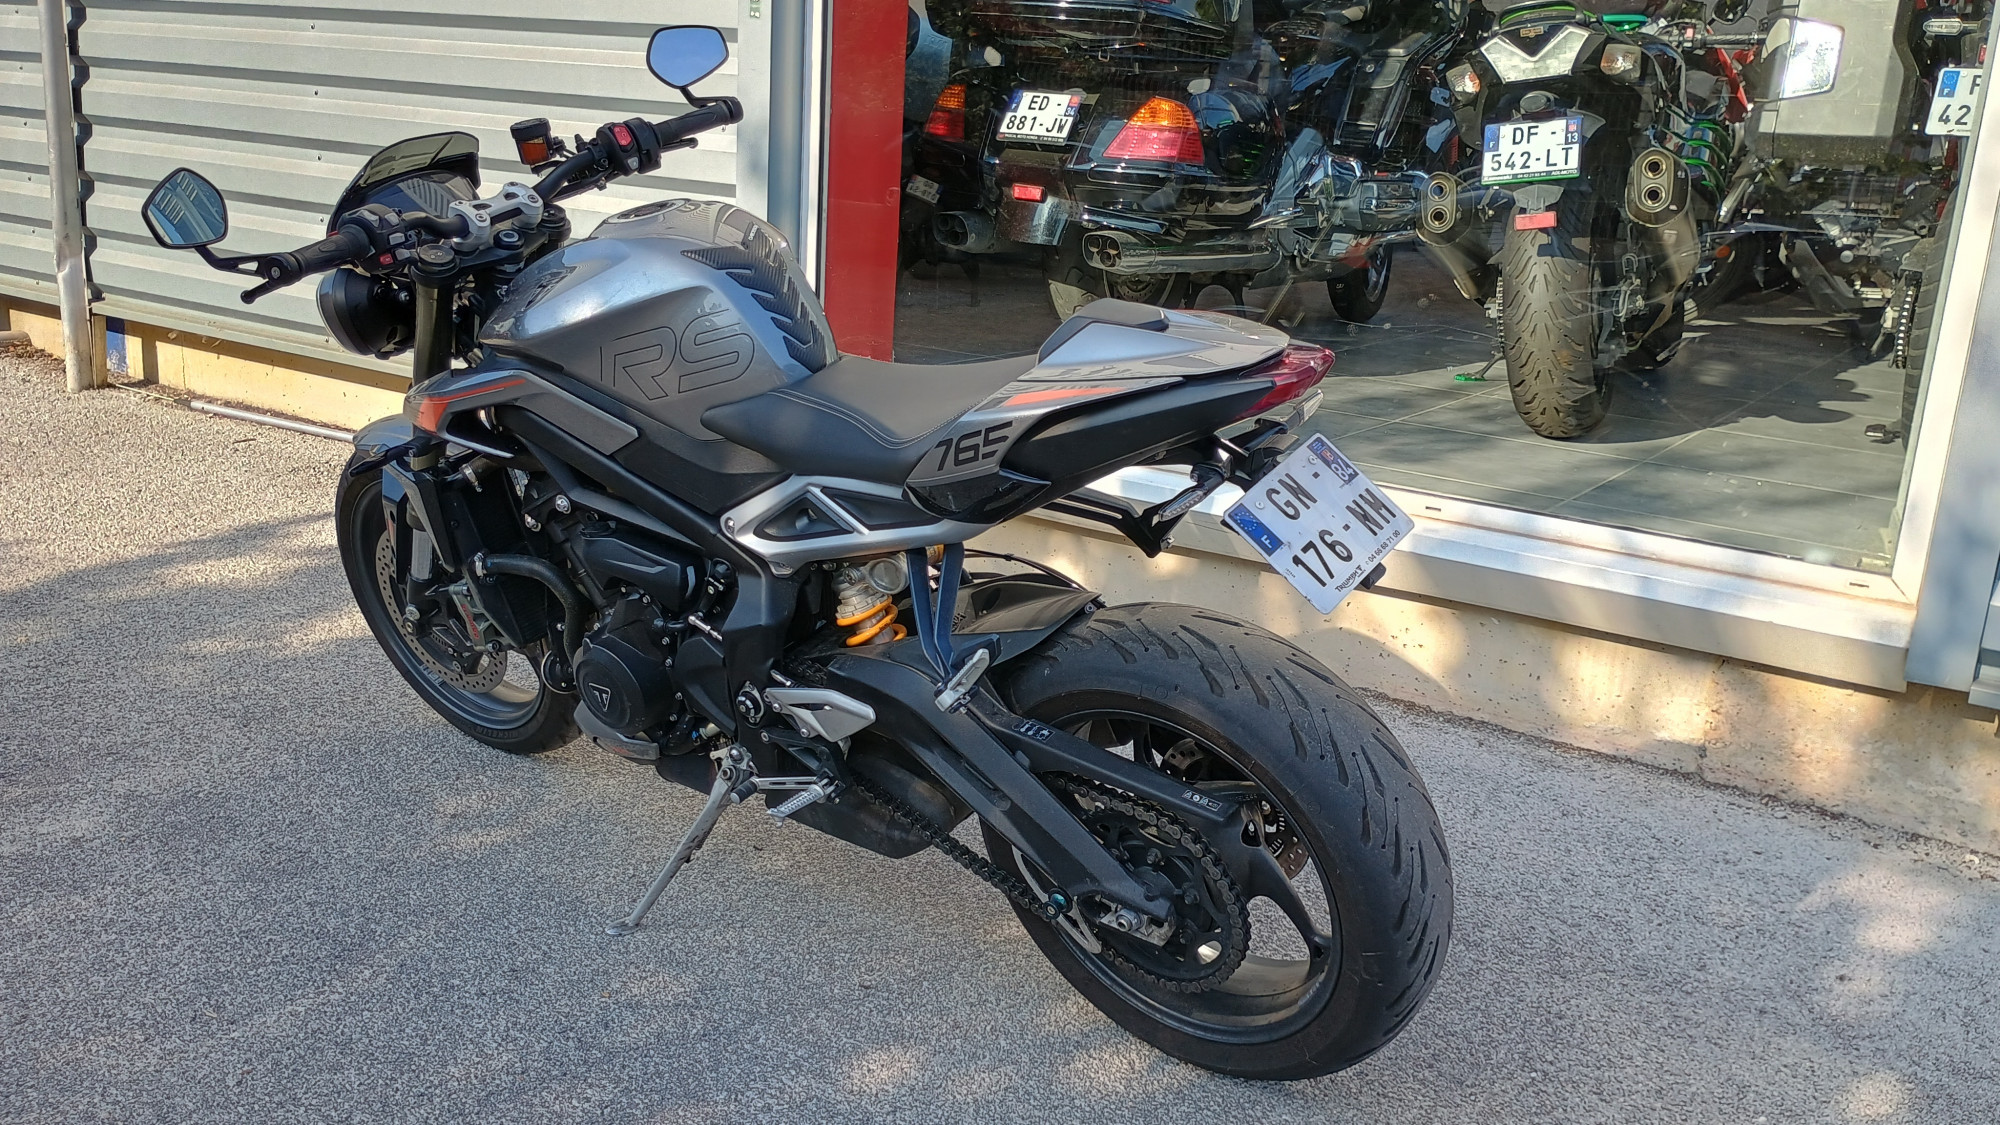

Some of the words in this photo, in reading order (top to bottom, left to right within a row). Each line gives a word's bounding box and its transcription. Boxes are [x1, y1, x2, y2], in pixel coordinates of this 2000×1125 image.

[1943, 88, 1951, 96] F
[1028, 95, 1050, 111] ED
[1065, 107, 1076, 116] 34
[1006, 114, 1069, 134] 881-JW
[1489, 141, 1495, 149] F
[1512, 125, 1539, 145] DF
[1567, 133, 1578, 143] 13
[1491, 147, 1573, 172] 542-LT
[600, 309, 755, 401] RS
[934, 420, 1014, 472] 765
[1331, 458, 1355, 480] 84
[1266, 473, 1317, 520] GN
[1261, 535, 1272, 549] F
[1368, 554, 1377, 563] 04
[1386, 536, 1394, 544] 71
[1393, 529, 1401, 538] 00
[1335, 570, 1359, 592] TRIUMPH
